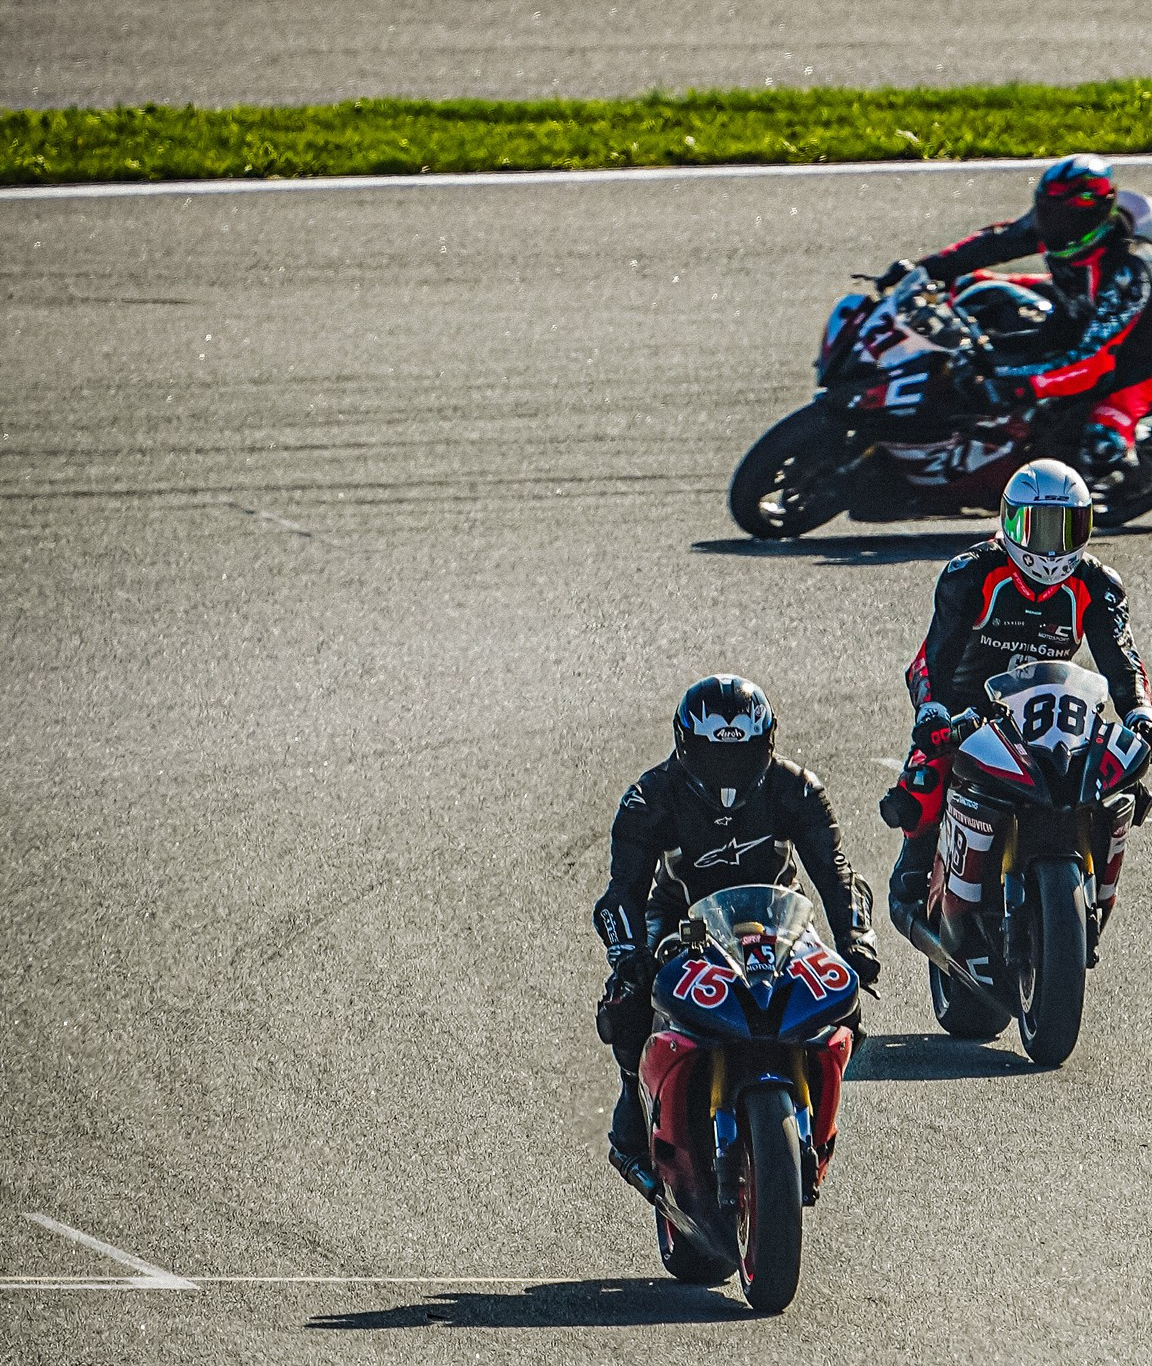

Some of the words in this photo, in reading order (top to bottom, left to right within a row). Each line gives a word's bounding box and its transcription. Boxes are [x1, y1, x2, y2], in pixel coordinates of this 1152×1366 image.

[980, 634, 1071, 658] Модульбанк
[716, 728, 742, 738] Airoh
[1022, 693, 1088, 736] 88
[673, 959, 737, 1009] 15
[786, 949, 851, 1001] 15
